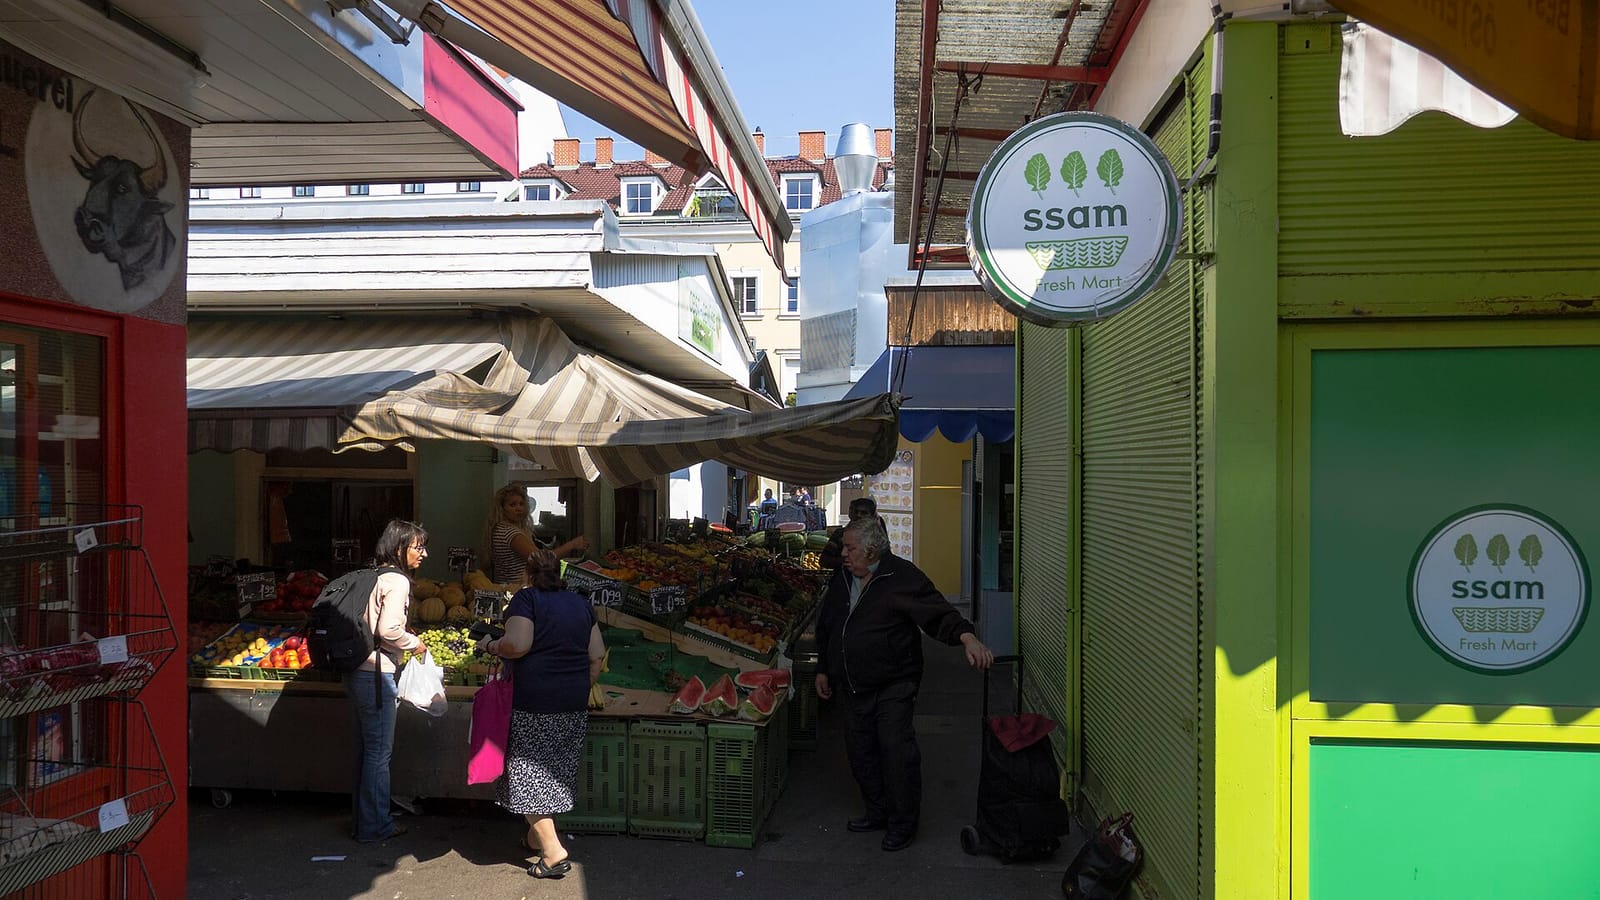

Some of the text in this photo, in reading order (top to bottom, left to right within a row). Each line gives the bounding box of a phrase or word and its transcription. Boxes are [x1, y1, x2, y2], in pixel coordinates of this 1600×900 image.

[0, 55, 73, 113] uerei
[1023, 204, 1128, 232] ssam
[1035, 275, 1123, 293] Fresh Mart
[1452, 580, 1545, 600] ssam
[1460, 637, 1538, 652] Fresh Mart
